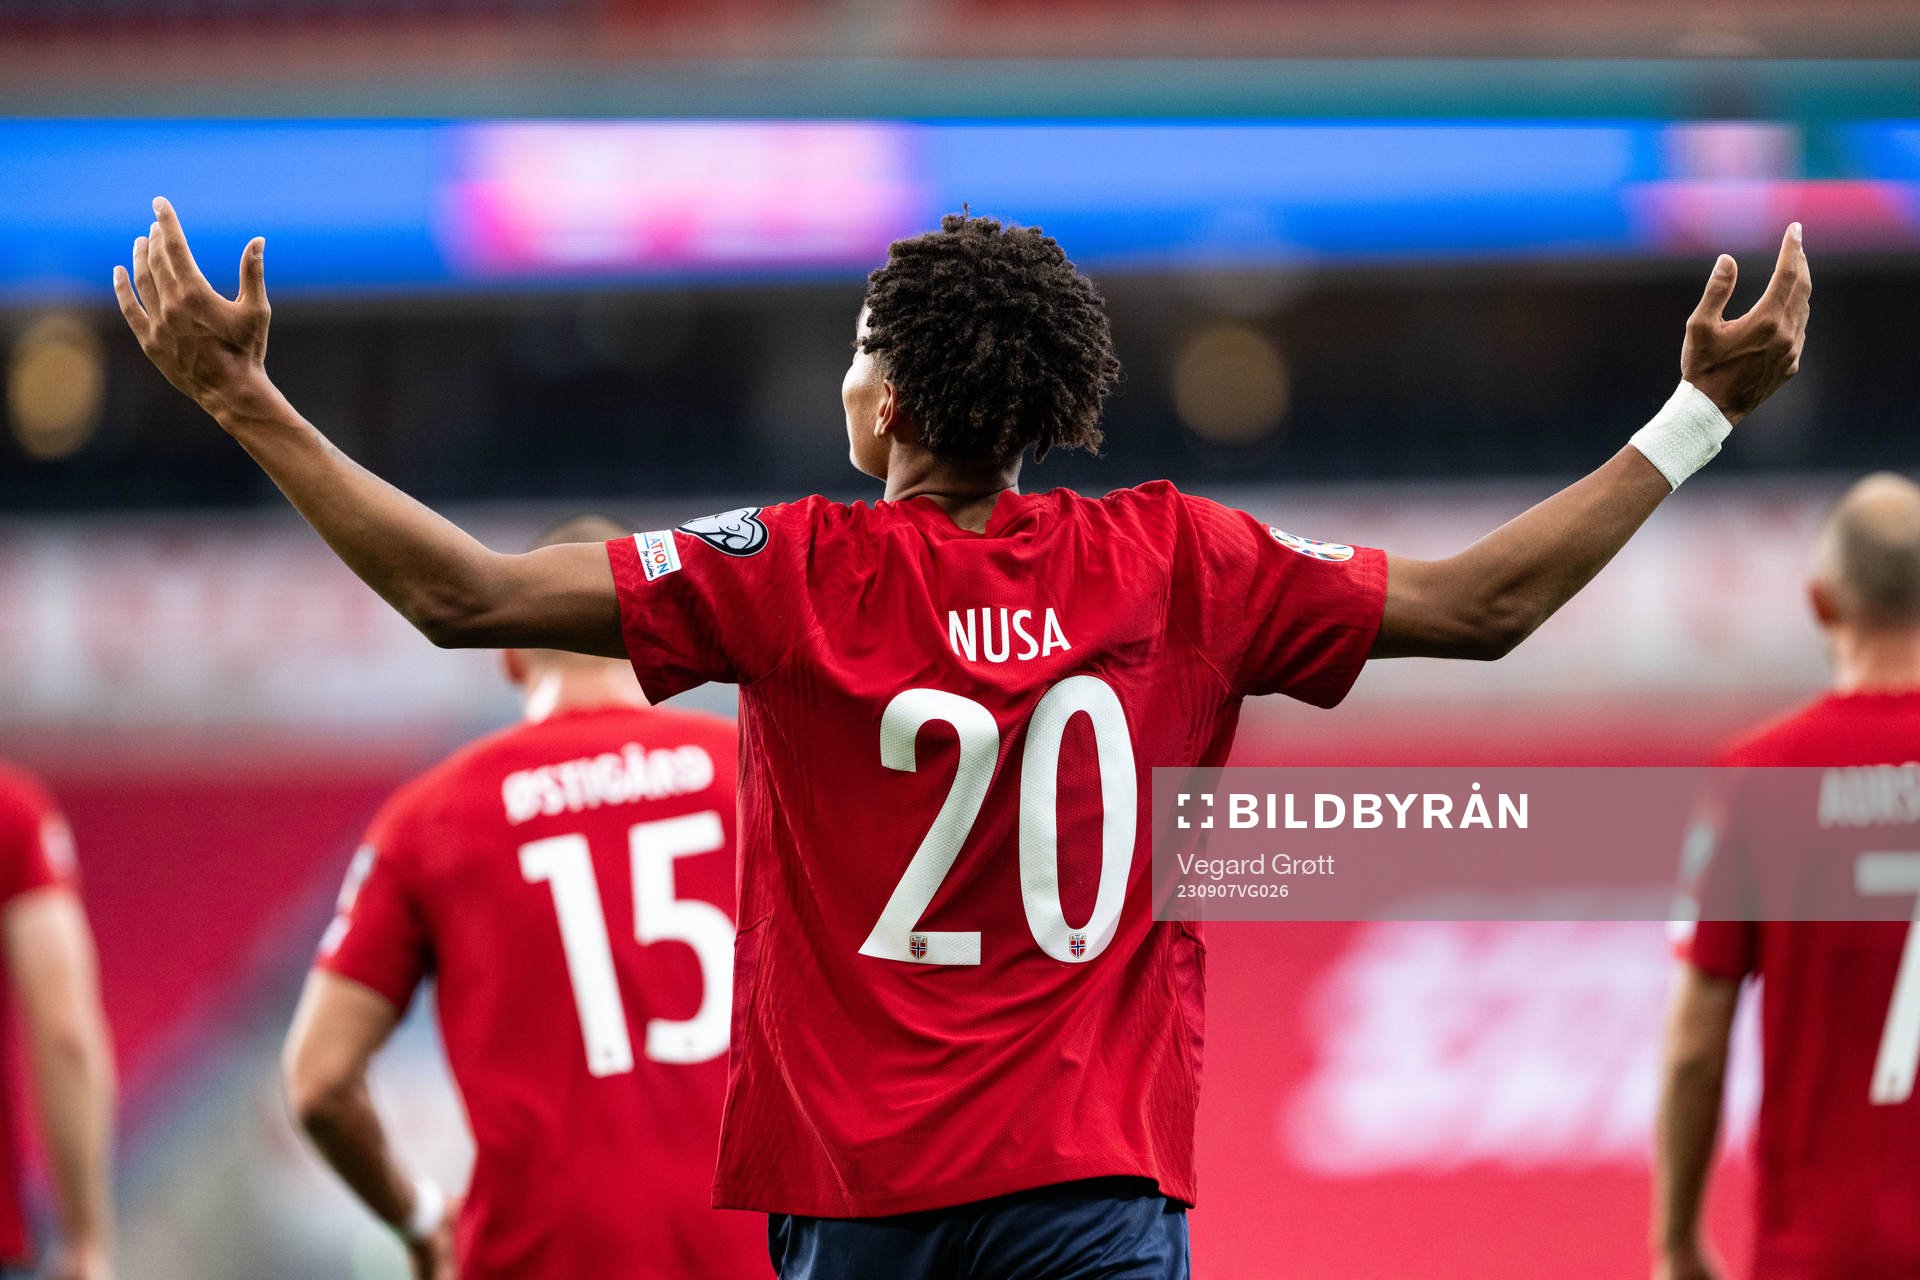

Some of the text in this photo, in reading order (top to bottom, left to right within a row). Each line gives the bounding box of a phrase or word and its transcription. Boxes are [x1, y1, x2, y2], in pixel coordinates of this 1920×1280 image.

[948, 607, 1072, 663] NUSA
[518, 810, 739, 1078] 15
[858, 675, 1138, 966] 20
